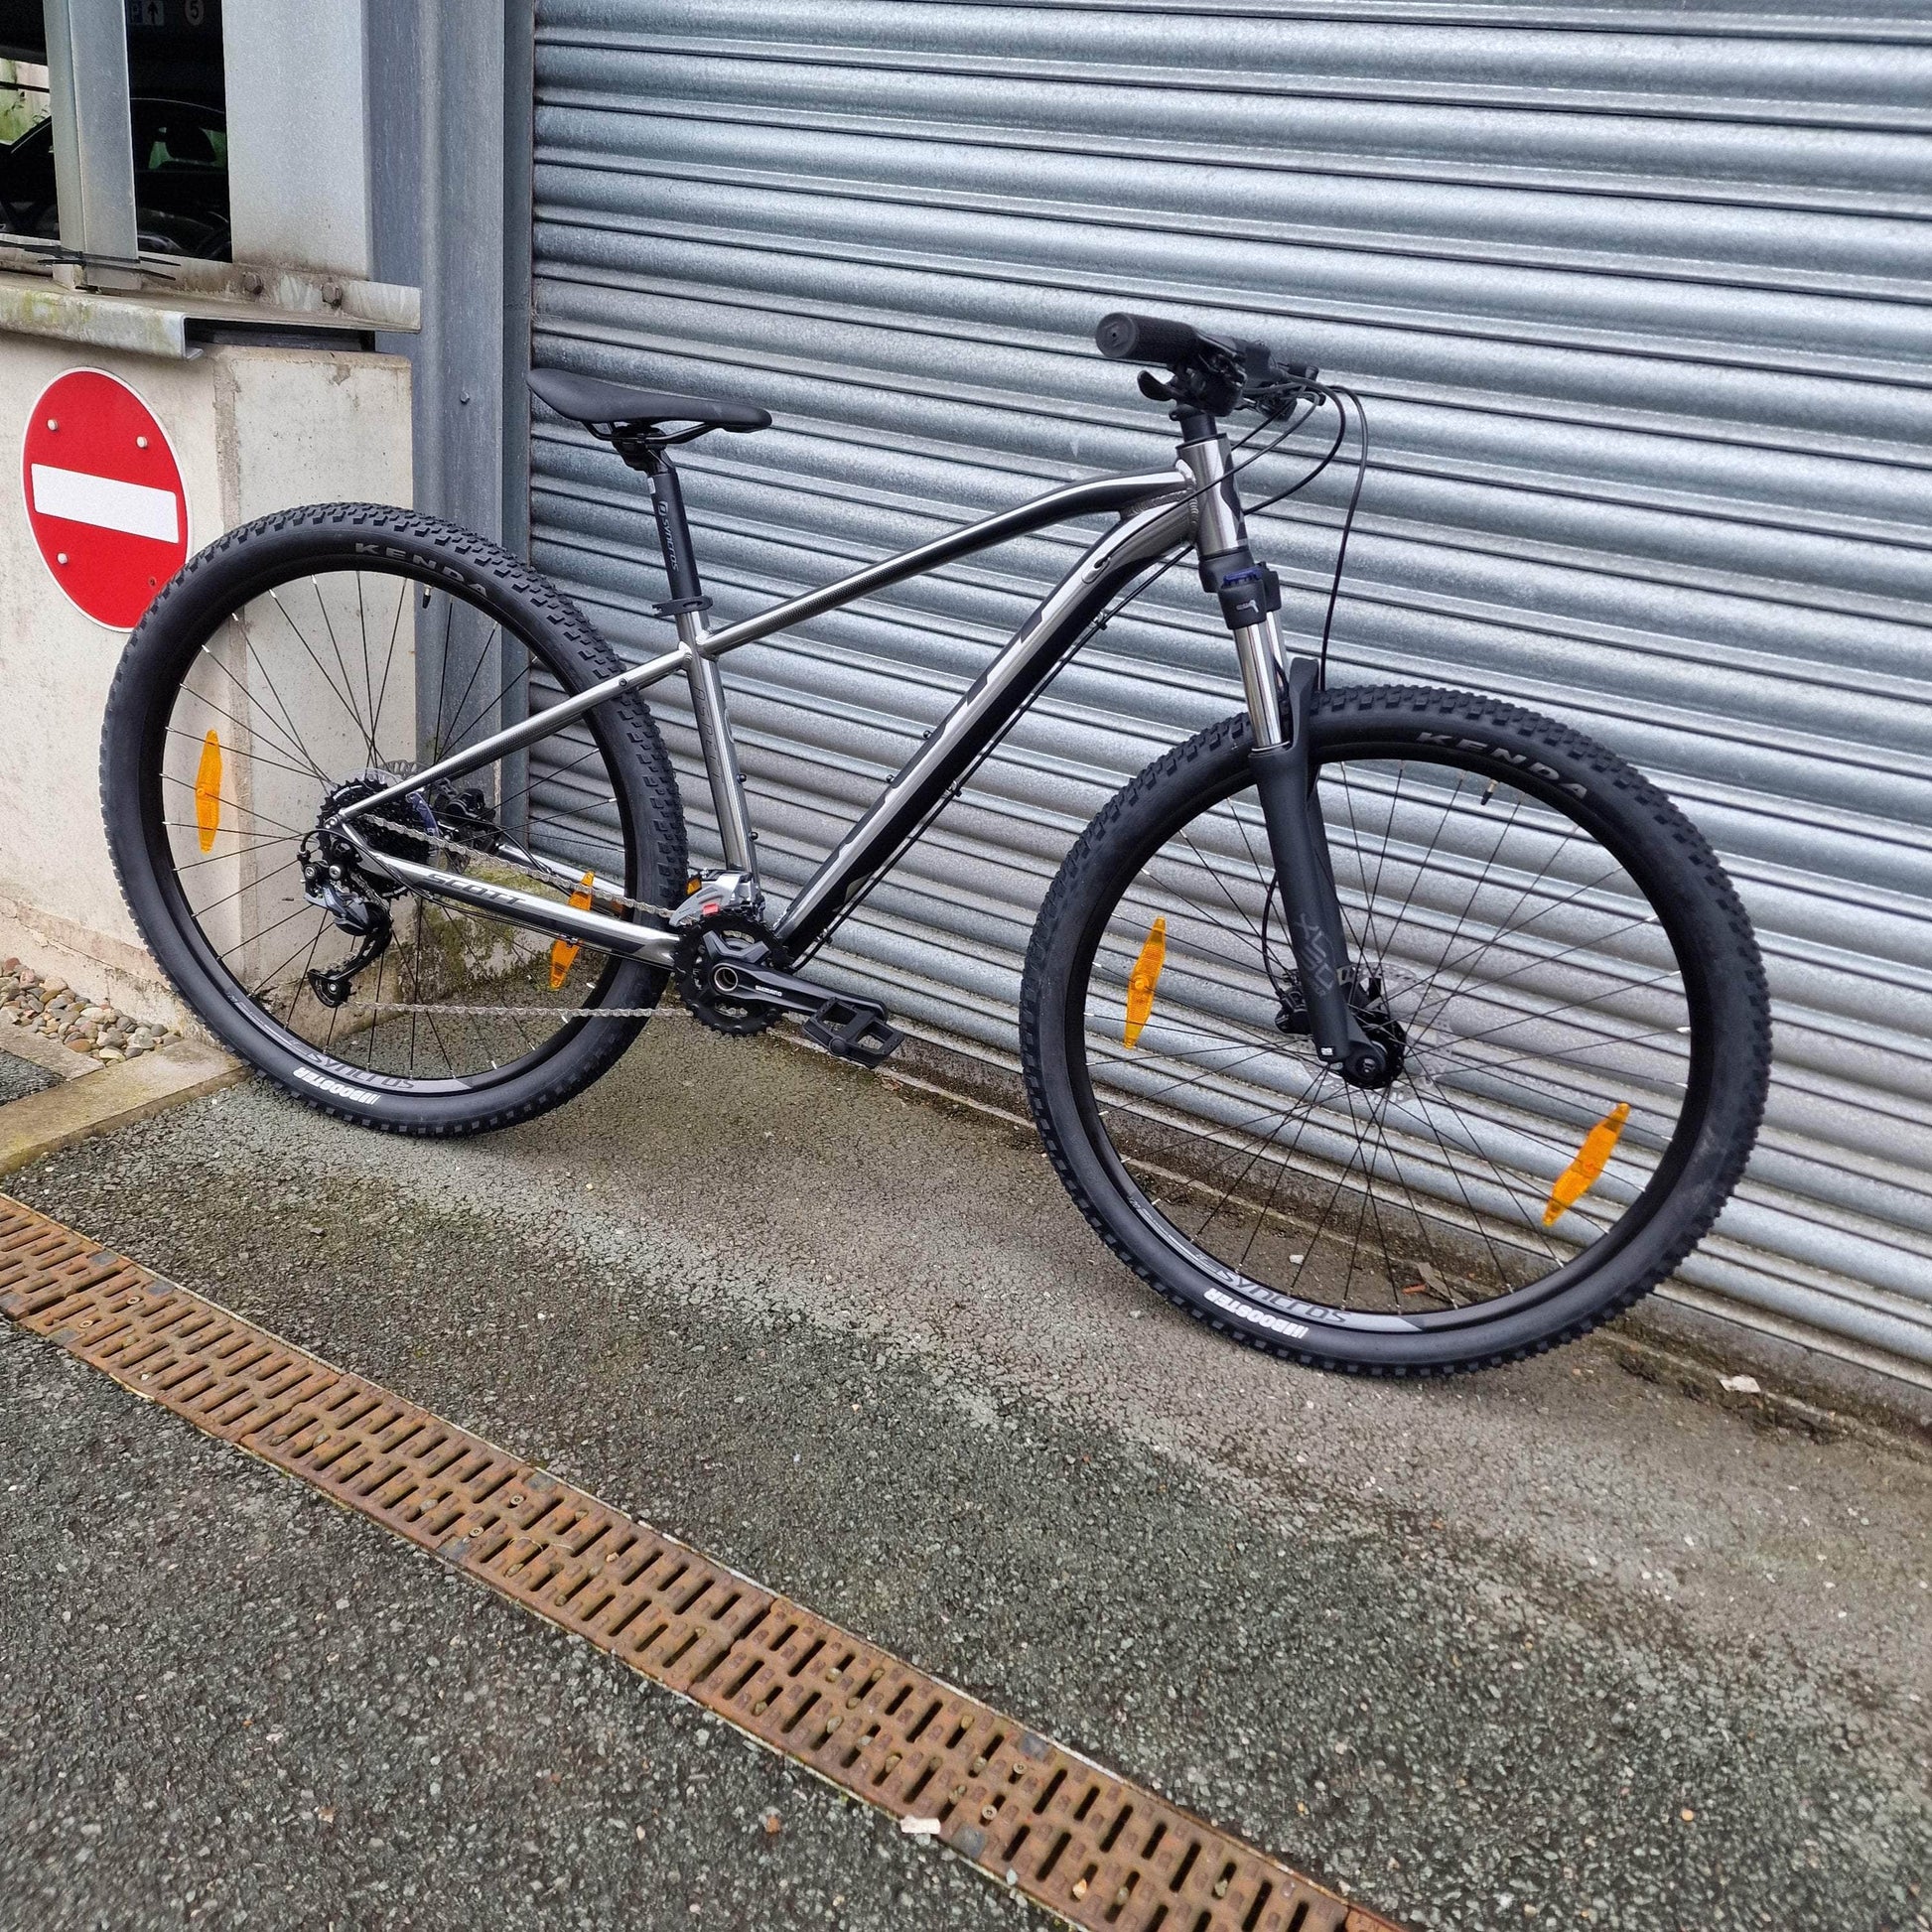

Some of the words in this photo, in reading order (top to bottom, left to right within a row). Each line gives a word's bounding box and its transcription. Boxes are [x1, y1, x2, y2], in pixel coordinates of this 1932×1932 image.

[355, 542, 487, 597] KENDA
[1416, 732, 1587, 799] KENDA
[423, 874, 526, 904] SCOTT
